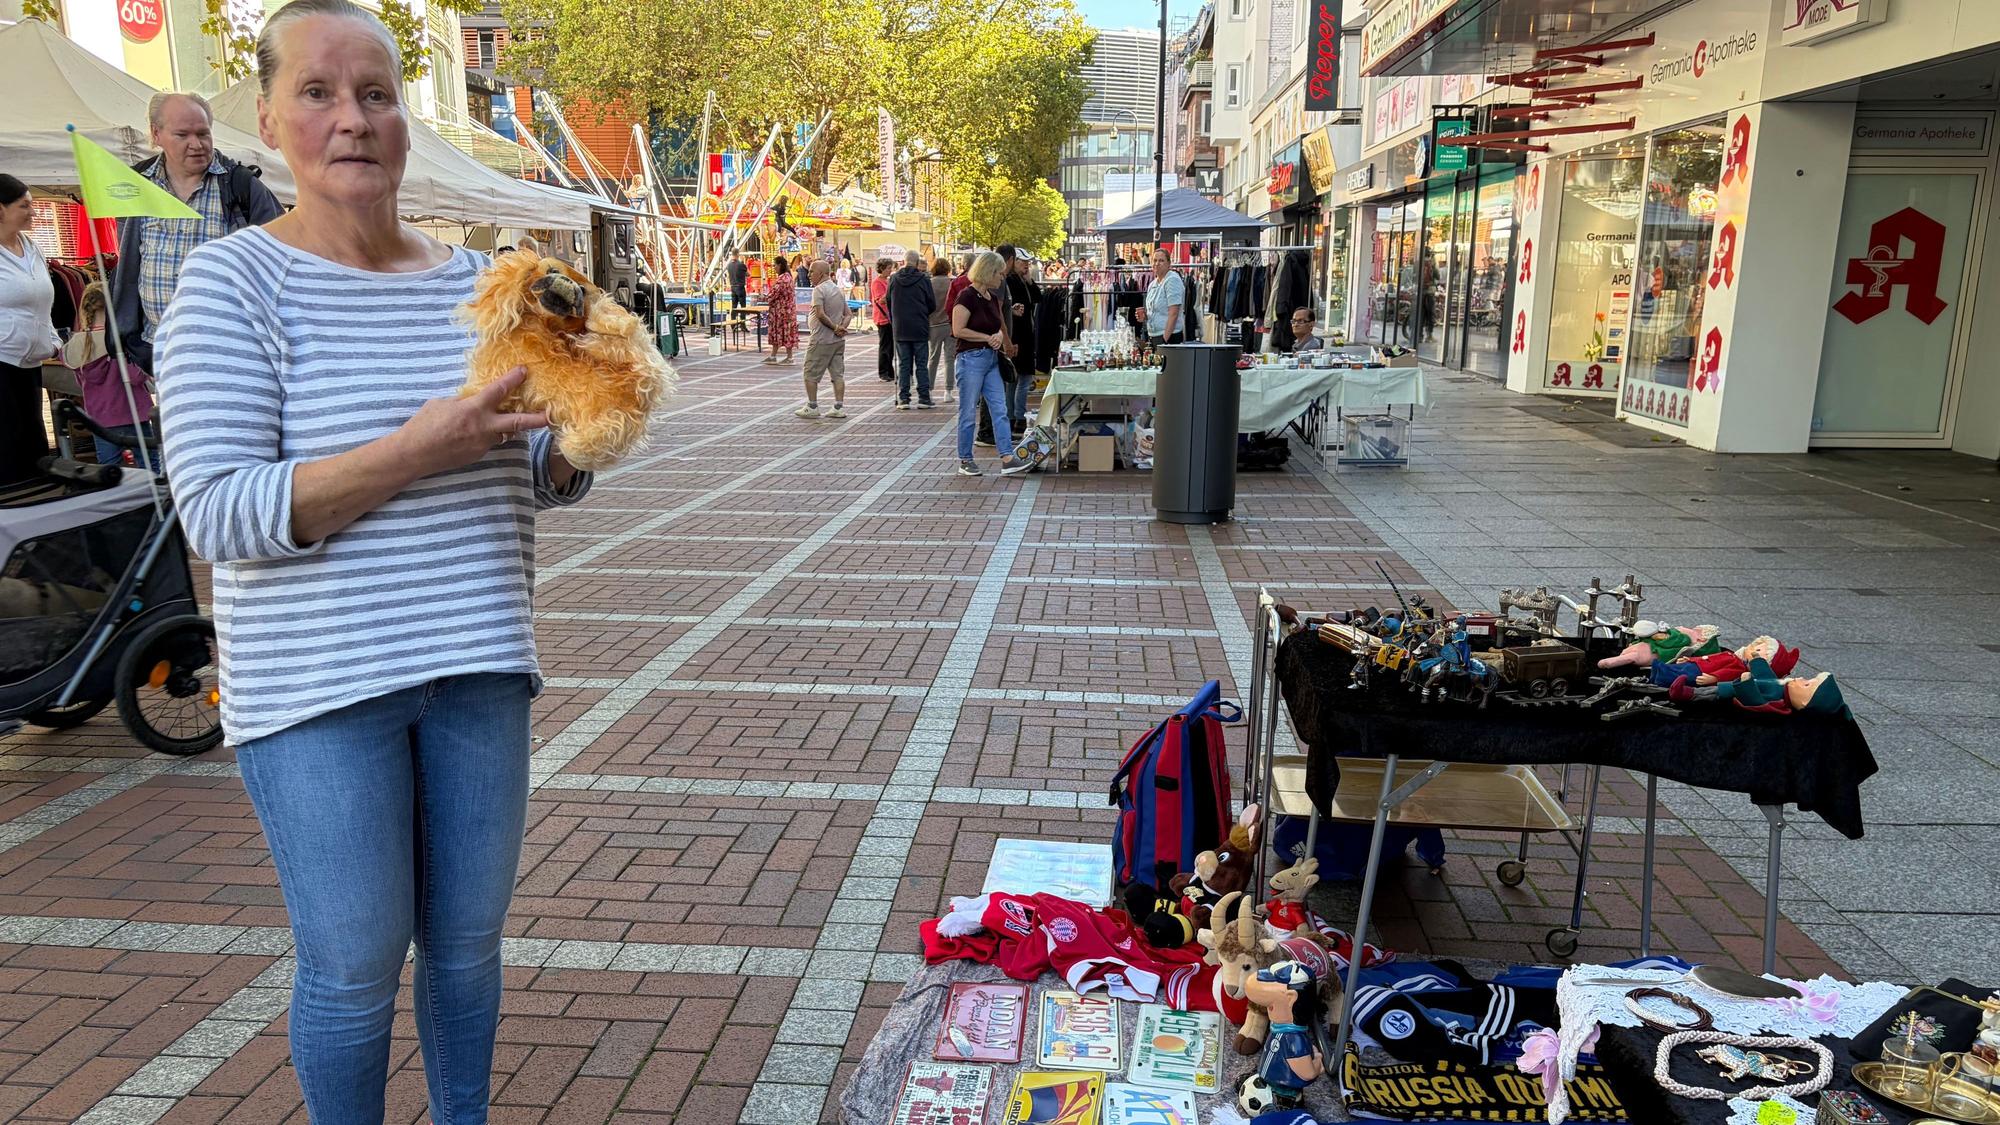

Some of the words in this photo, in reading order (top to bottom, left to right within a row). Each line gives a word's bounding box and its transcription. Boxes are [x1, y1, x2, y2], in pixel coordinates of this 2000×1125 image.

[121, 0, 157, 24] 60%
[1808, 5, 1828, 25] MODE
[1309, 4, 1336, 100] Pieper
[1651, 53, 1692, 84] Germania
[1707, 30, 1757, 68] Apotheke
[1856, 125, 1916, 139] Germania
[1920, 127, 1976, 142] Apotheke
[880, 115, 890, 200] Reibekuchen
[1069, 236, 1105, 244] RATHAUS
[1587, 232, 1637, 241] Germania
[984, 994, 1017, 1051] INDIAN
